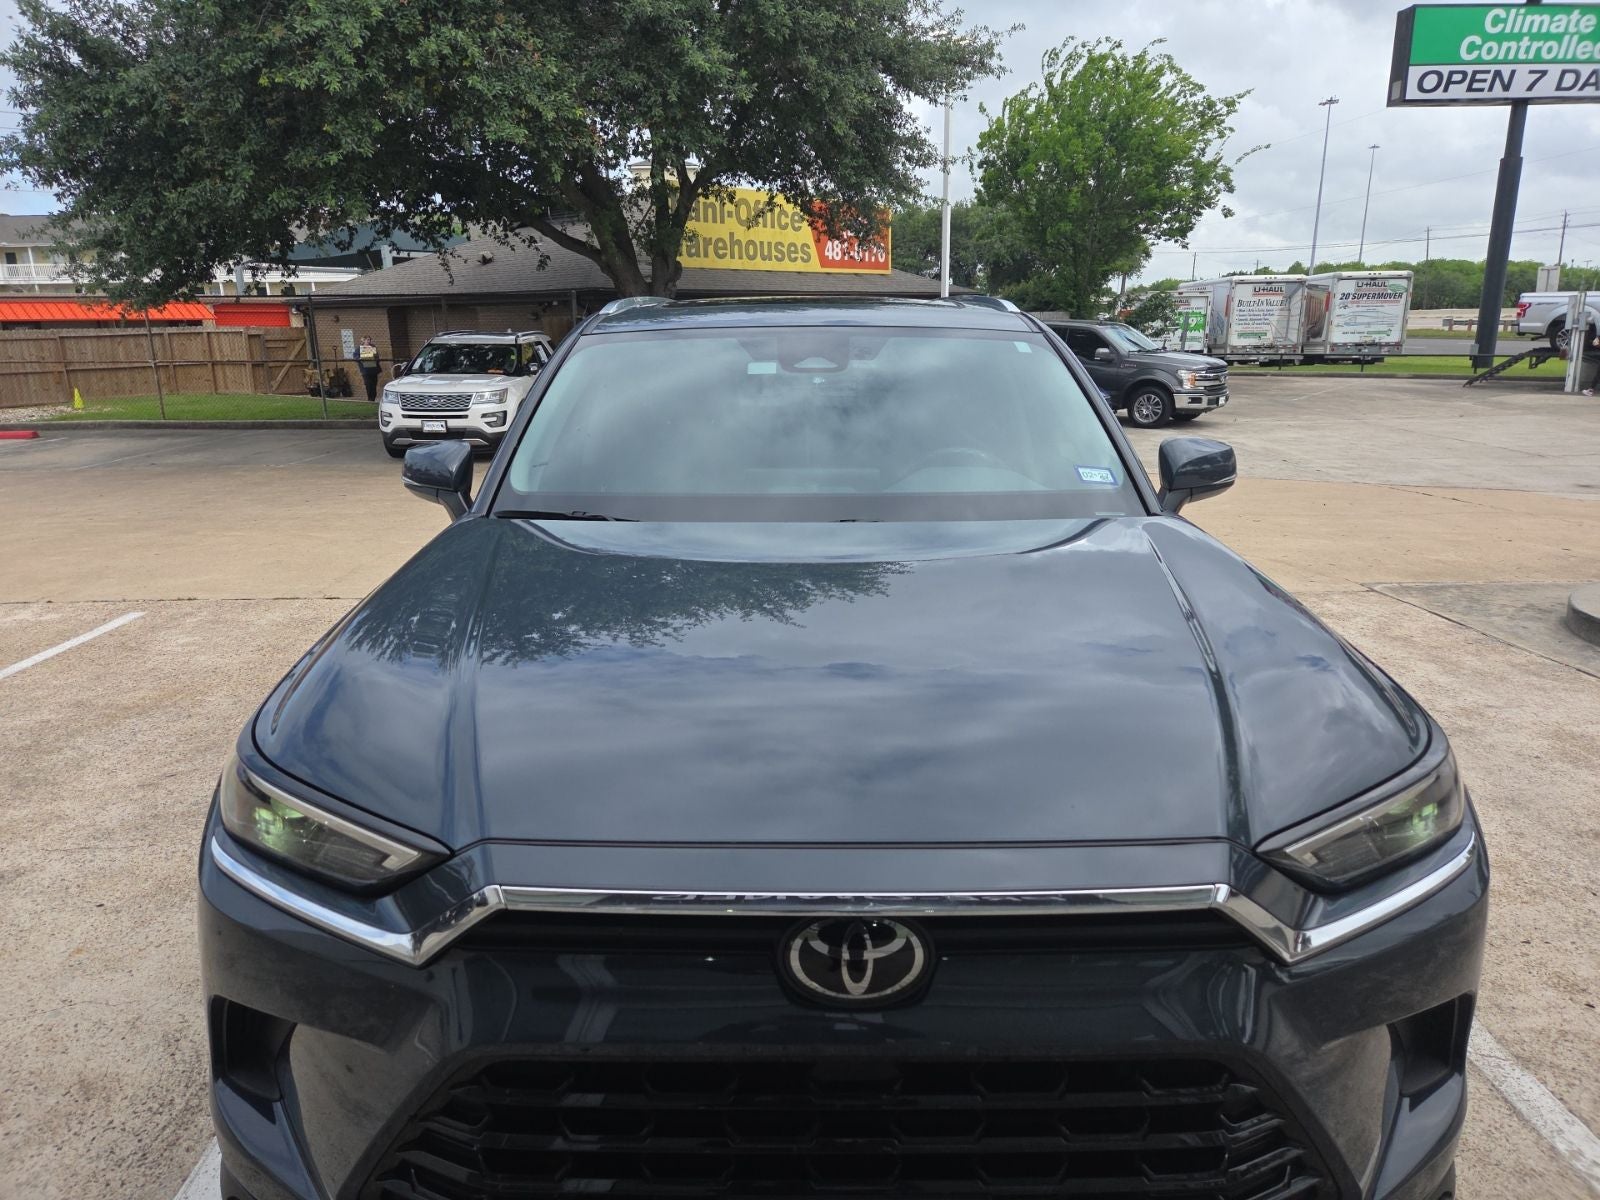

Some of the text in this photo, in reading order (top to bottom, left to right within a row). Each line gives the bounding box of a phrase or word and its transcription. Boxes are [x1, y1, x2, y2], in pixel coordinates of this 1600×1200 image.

[1484, 8, 1597, 34] Climate
[1416, 69, 1516, 94] OPEN
[1525, 69, 1549, 92] 7
[688, 197, 803, 232] ini-Office
[679, 232, 812, 263] arehouses
[1351, 292, 1404, 301] SUPERMOVER
